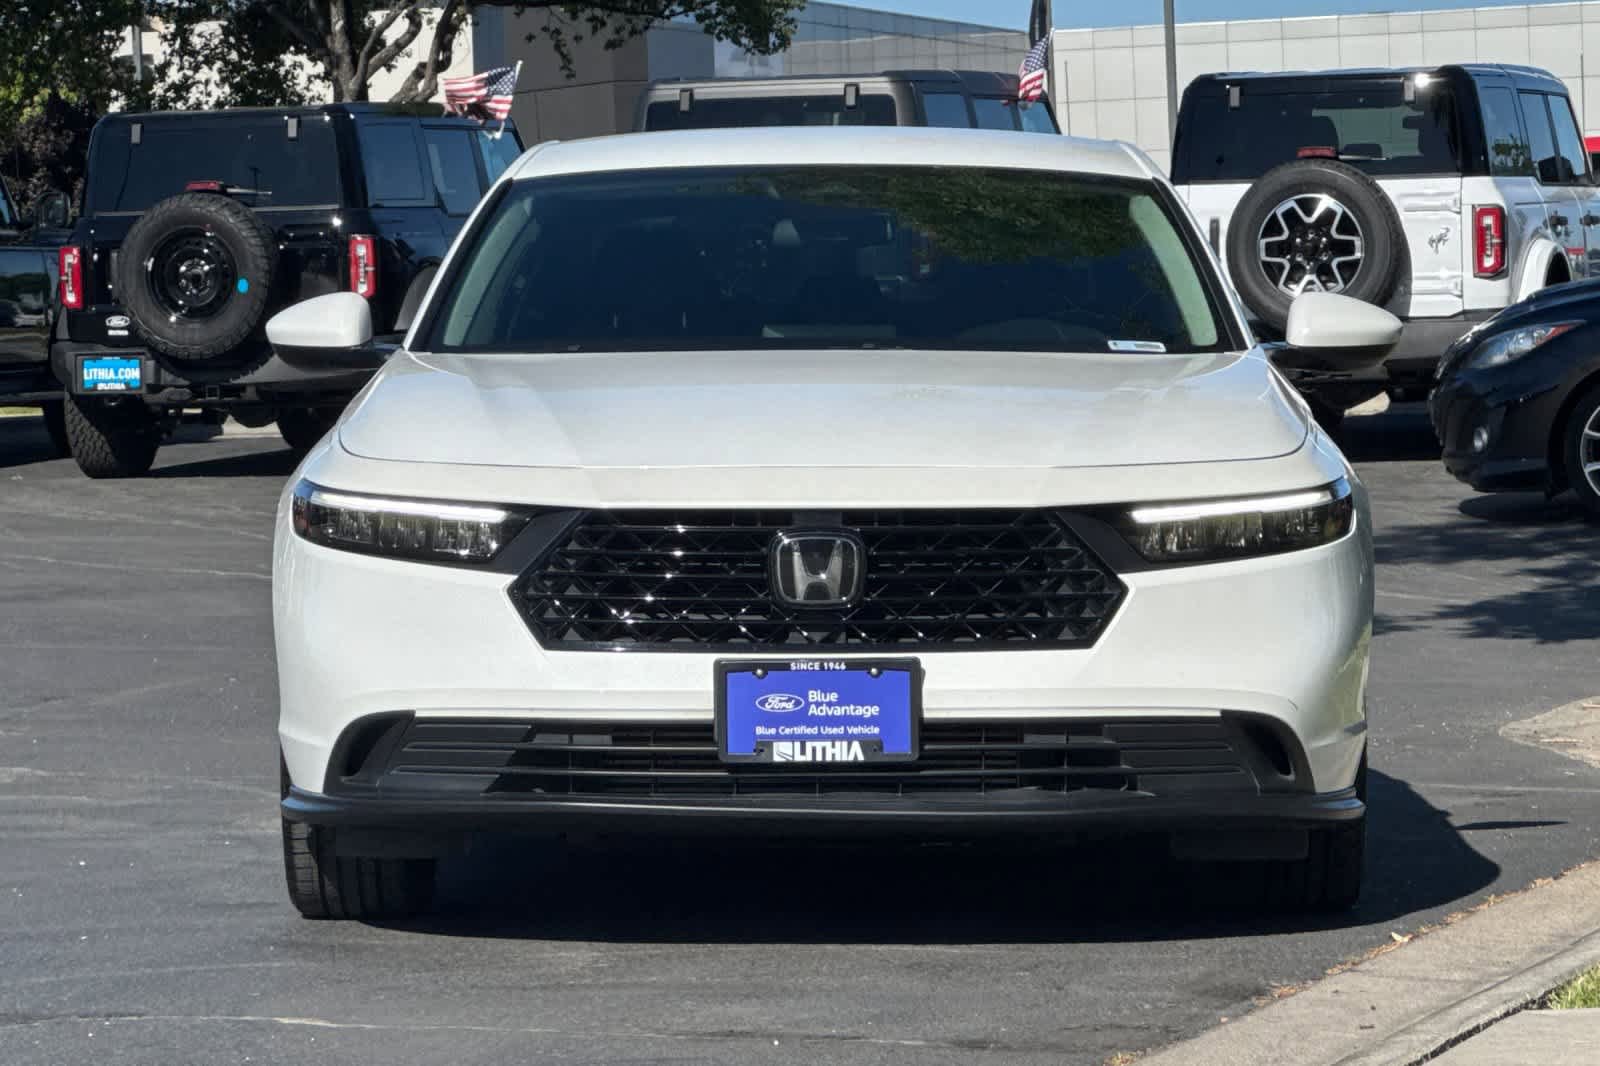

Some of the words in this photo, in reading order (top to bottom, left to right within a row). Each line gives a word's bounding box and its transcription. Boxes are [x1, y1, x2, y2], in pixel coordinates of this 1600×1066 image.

[83, 368, 140, 380] LITHIA.COM
[790, 662, 820, 670] SINCE
[824, 662, 846, 670] 1946
[808, 690, 838, 702] Blue
[764, 696, 796, 709] Ford
[808, 704, 880, 718] Advantage
[756, 726, 777, 735] Blue
[779, 726, 818, 735] Certified
[820, 726, 844, 735] Used
[847, 726, 880, 735] Vehicle
[794, 741, 865, 761] LITHIA
